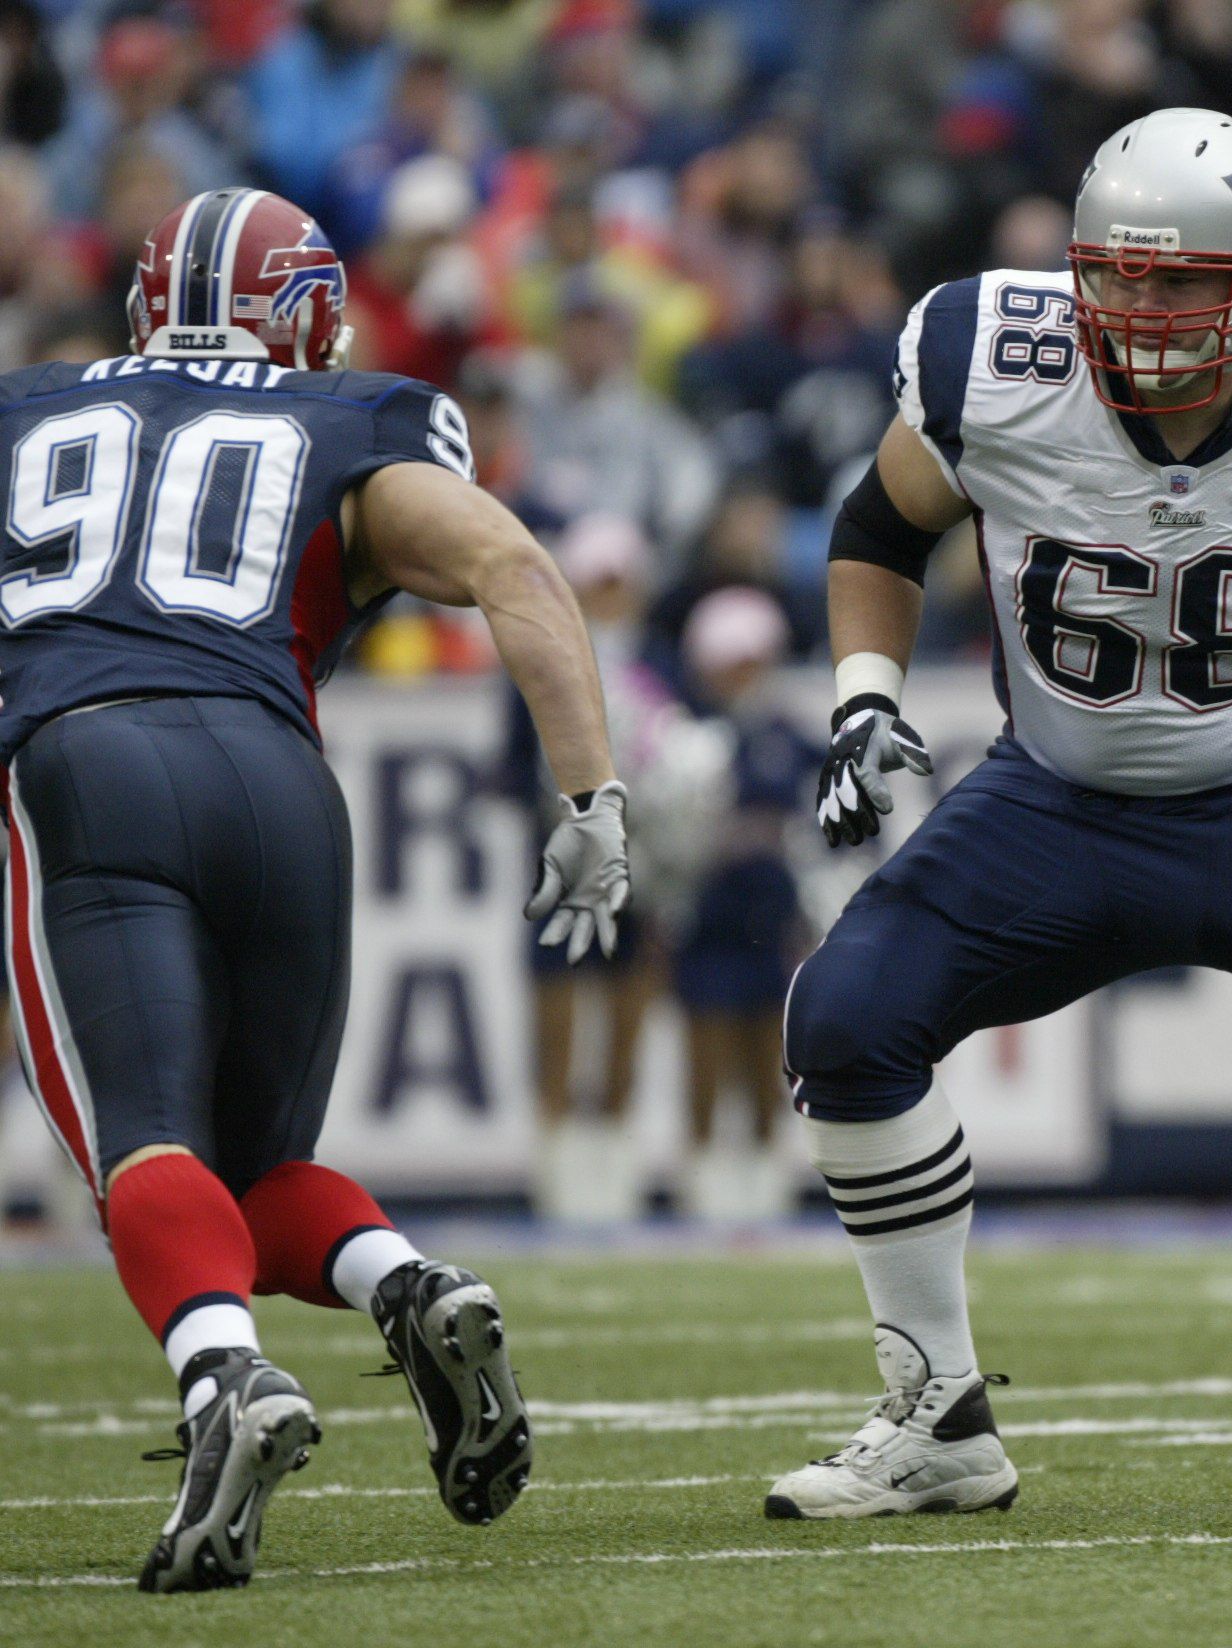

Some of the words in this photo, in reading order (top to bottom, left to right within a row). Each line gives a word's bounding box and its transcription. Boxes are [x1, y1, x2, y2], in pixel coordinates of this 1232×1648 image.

[1124, 230, 1161, 245] Riddell
[168, 333, 227, 350] BILLS
[988, 280, 1079, 386] 68
[0, 400, 312, 630] 90
[1149, 505, 1207, 529] Patriots
